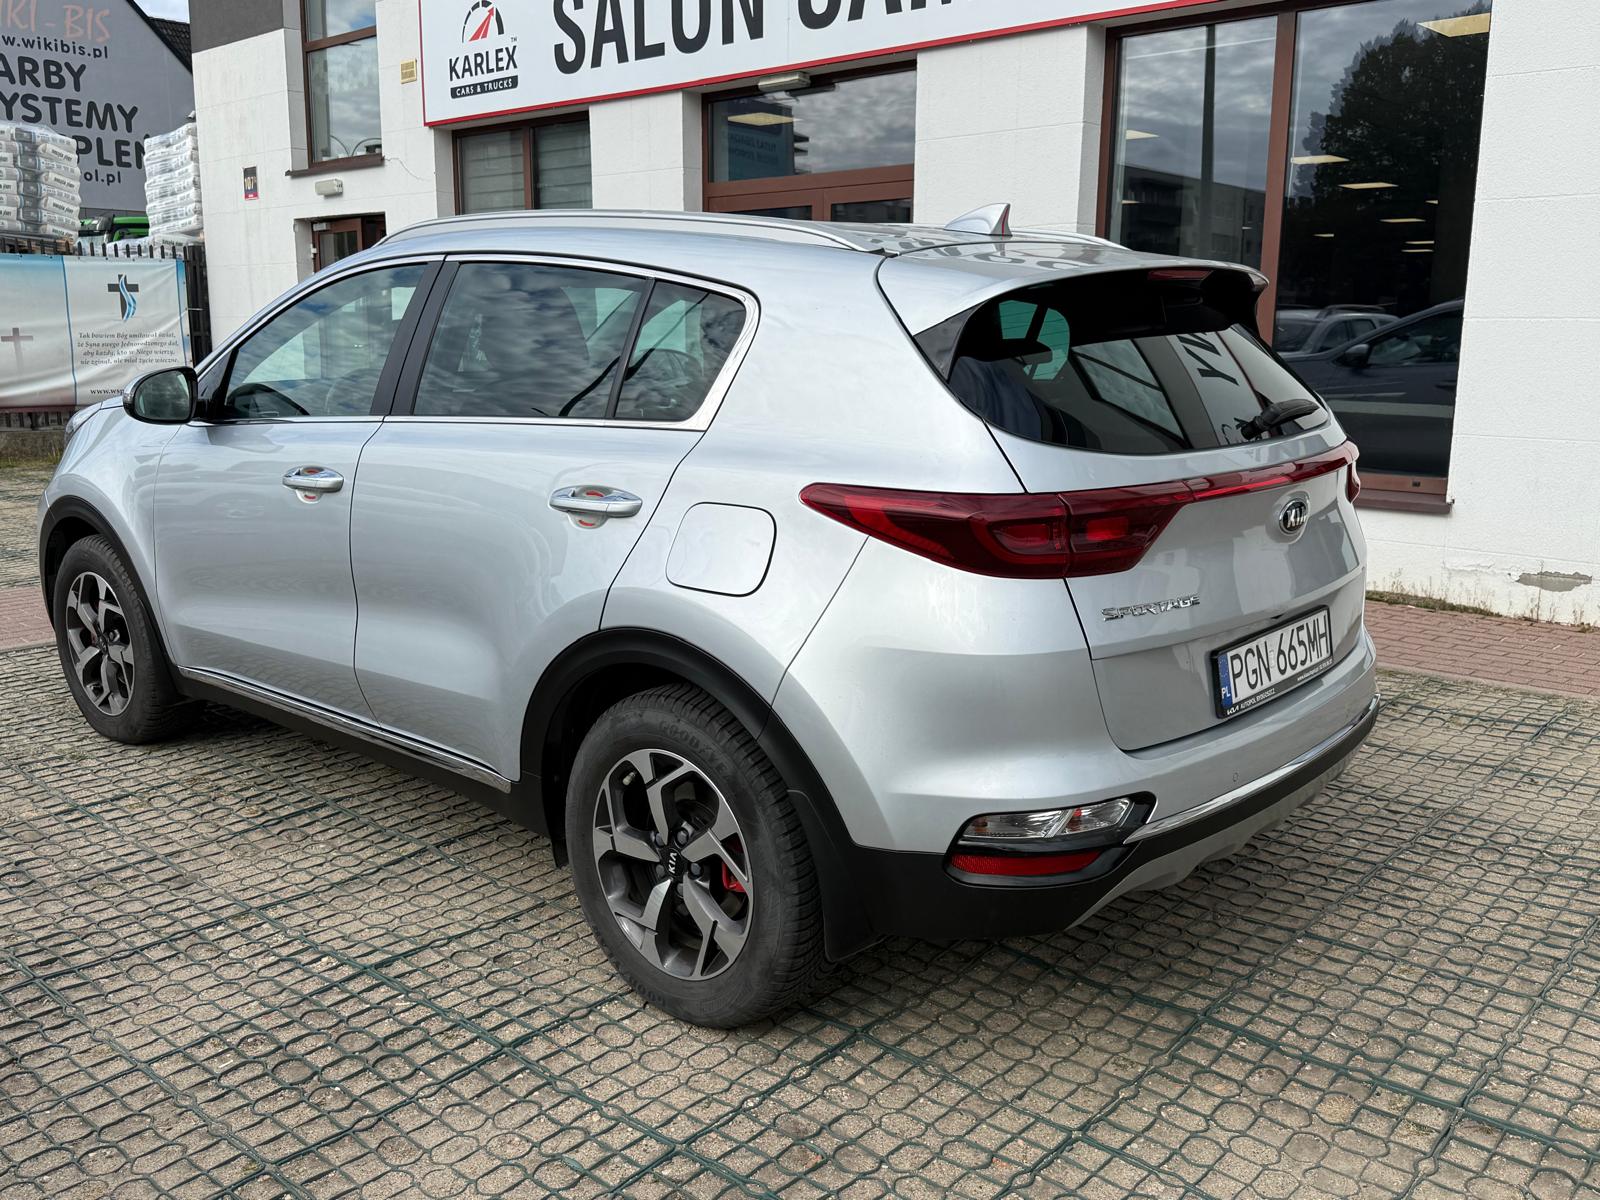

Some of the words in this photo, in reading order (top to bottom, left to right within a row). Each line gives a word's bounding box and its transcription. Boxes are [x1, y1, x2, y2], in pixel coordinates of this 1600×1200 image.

[2, 35, 108, 59] w.wikibis.pl
[0, 53, 86, 92] ARBY
[449, 45, 518, 82] KARLEX
[455, 86, 474, 97] CARS
[476, 85, 482, 93] &
[483, 78, 512, 92] TRUCKS
[0, 92, 138, 133] YSTEMY
[81, 169, 121, 186] ol.pl
[1101, 595, 1200, 621] SPORTAGE
[1230, 640, 1272, 698] PGN
[1276, 614, 1330, 676] 665MH
[1221, 687, 1231, 699] PL
[668, 852, 677, 874] KIA
